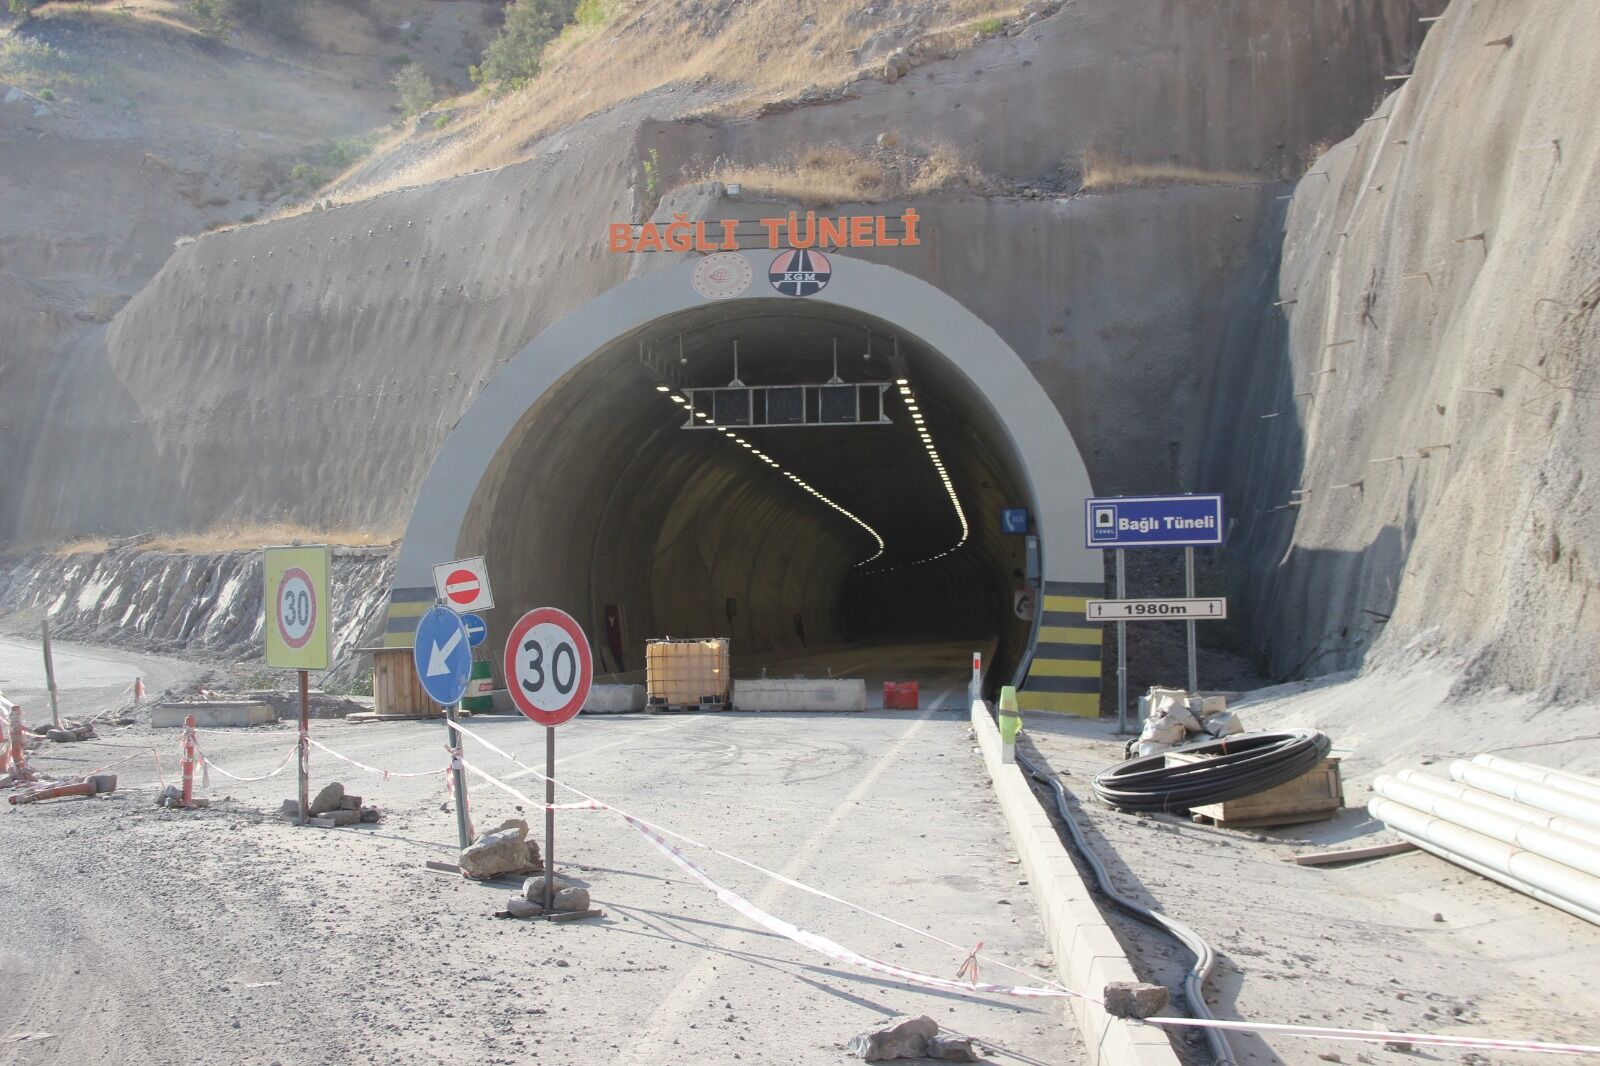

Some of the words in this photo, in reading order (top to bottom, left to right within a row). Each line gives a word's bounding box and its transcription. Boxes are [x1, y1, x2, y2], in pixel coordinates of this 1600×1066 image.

[608, 212, 740, 253] BAĞLI
[760, 208, 920, 249] TÜNELİ
[784, 273, 816, 281] KGM
[1119, 518, 1159, 533] Bağlı
[1164, 516, 1215, 530] Tüneli
[284, 590, 308, 626] 30
[1124, 604, 1187, 614] 1980m
[522, 639, 577, 695] 30
